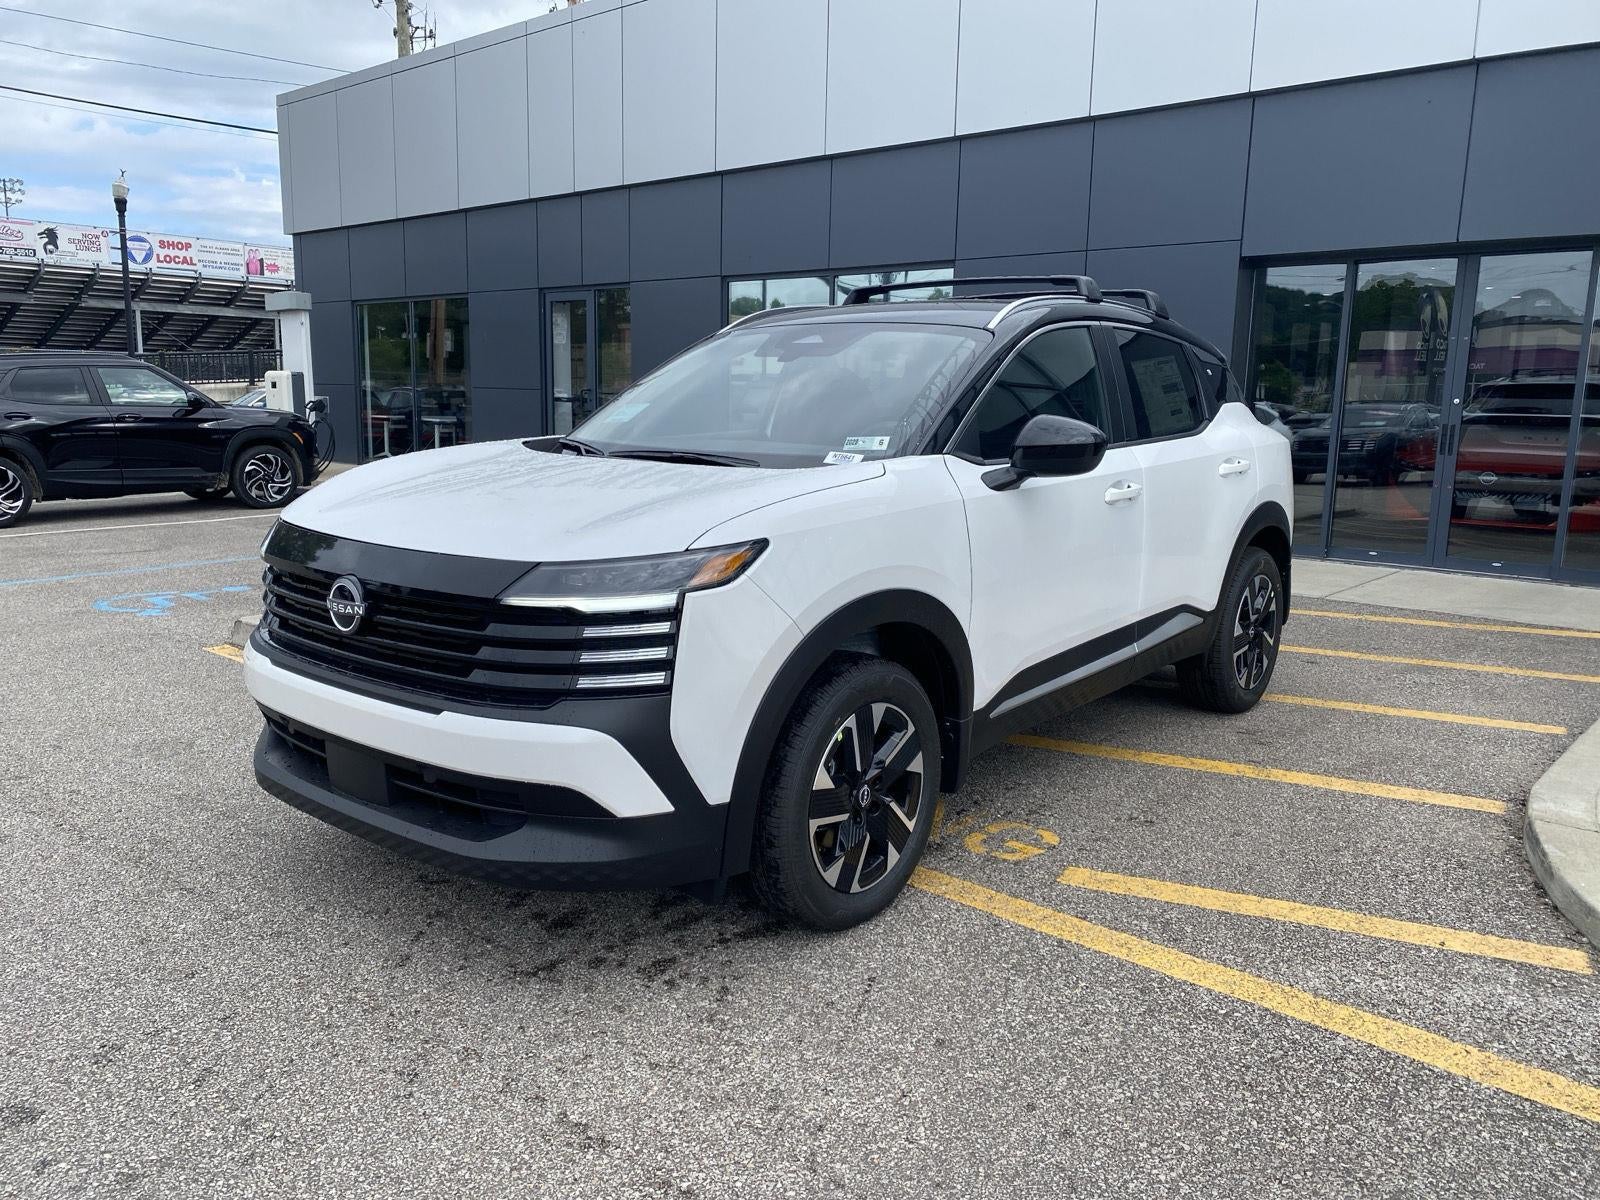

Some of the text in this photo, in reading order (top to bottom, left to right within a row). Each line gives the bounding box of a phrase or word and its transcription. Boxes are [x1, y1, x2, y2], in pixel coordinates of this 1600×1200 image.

[67, 237, 101, 247] SERVING
[75, 244, 102, 253] LUNCH
[158, 239, 192, 252] SHOP
[156, 253, 197, 267] LOCAL
[328, 601, 363, 615] NISSAN
